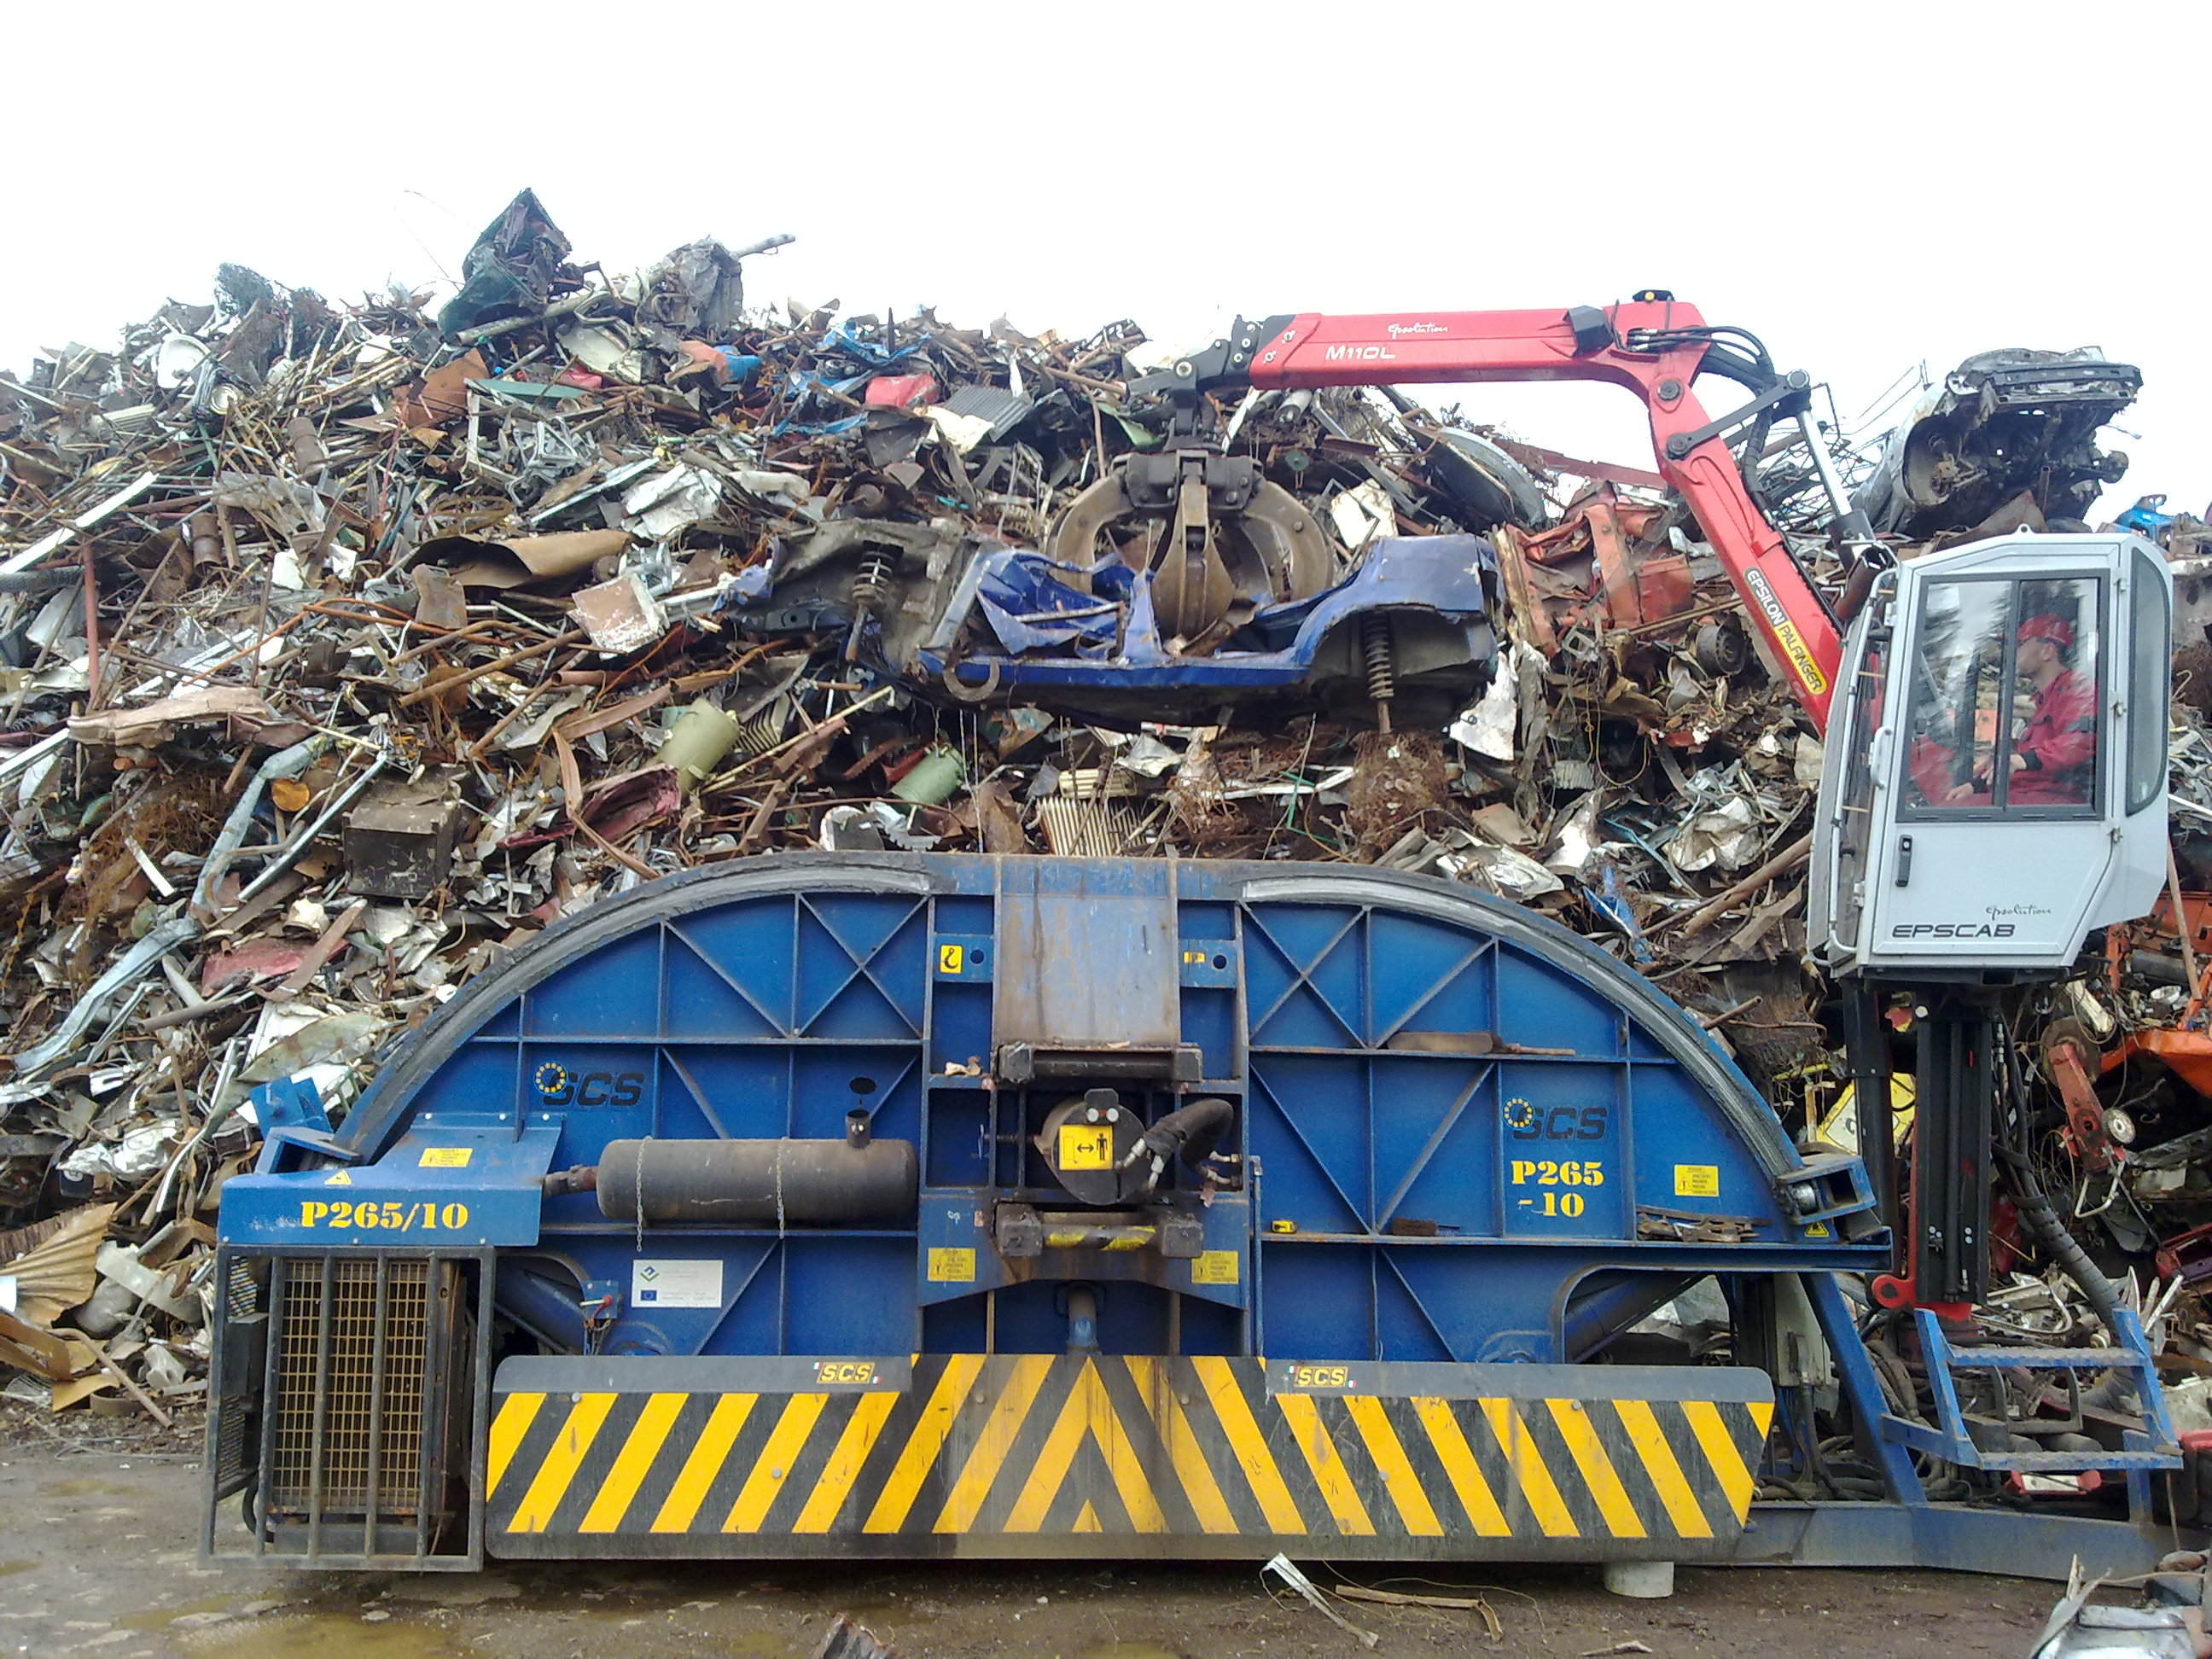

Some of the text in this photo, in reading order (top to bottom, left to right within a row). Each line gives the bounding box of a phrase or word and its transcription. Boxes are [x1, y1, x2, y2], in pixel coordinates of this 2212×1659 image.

[1325, 345, 1396, 361] M110L
[1747, 570, 1824, 691] EPSILON PALFINGER
[1892, 924, 2016, 938] EPSCAB
[1511, 1161, 1604, 1186] P265
[300, 1201, 469, 1232] P265/10
[821, 1365, 871, 1382] SCS
[1298, 1368, 1345, 1385] SCS
